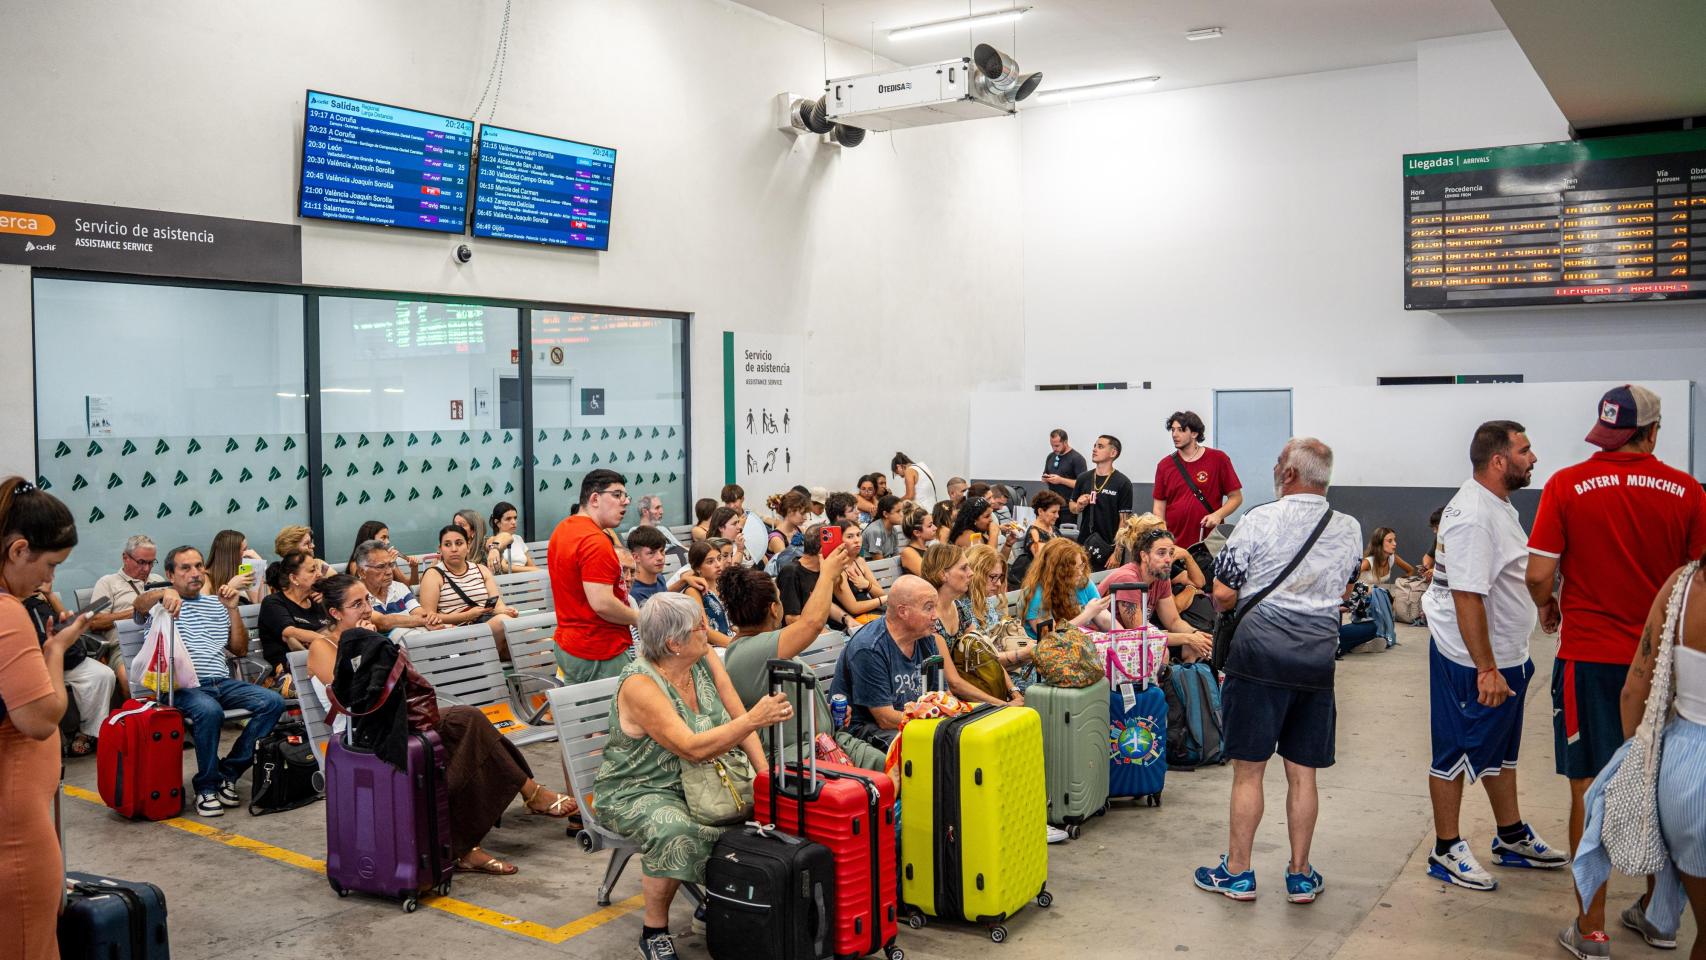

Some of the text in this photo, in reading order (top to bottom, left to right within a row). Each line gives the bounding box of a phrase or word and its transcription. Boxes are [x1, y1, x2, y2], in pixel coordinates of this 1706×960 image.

[331, 100, 360, 112] Salidas
[310, 110, 328, 118] 19:17
[335, 114, 356, 123] Coruña
[309, 125, 327, 134] 20:23
[334, 129, 356, 138] Coruña
[308, 140, 326, 149] 20:30
[307, 156, 395, 175] 20:30 València Joaquín Sorolla
[1409, 156, 1490, 170] Llegadas ARRIVALS
[306, 171, 394, 189] 20:45 València Joaquín Sorolla
[497, 171, 520, 180] Valladolid
[305, 186, 393, 204] 21:00 València Joaquín Sorolla
[521, 188, 538, 196] Carmen
[304, 201, 354, 213] 21:11 Salamanca
[494, 198, 516, 207] Zaragoza
[493, 211, 513, 219] València
[75, 218, 214, 243] Servicio de asistencia
[75, 238, 153, 252] ASSISTANCE SERVICE
[745, 350, 772, 360] Servicio
[746, 362, 790, 373] de asistencia
[1574, 474, 1686, 498] BAYERN MÜNCHEN
